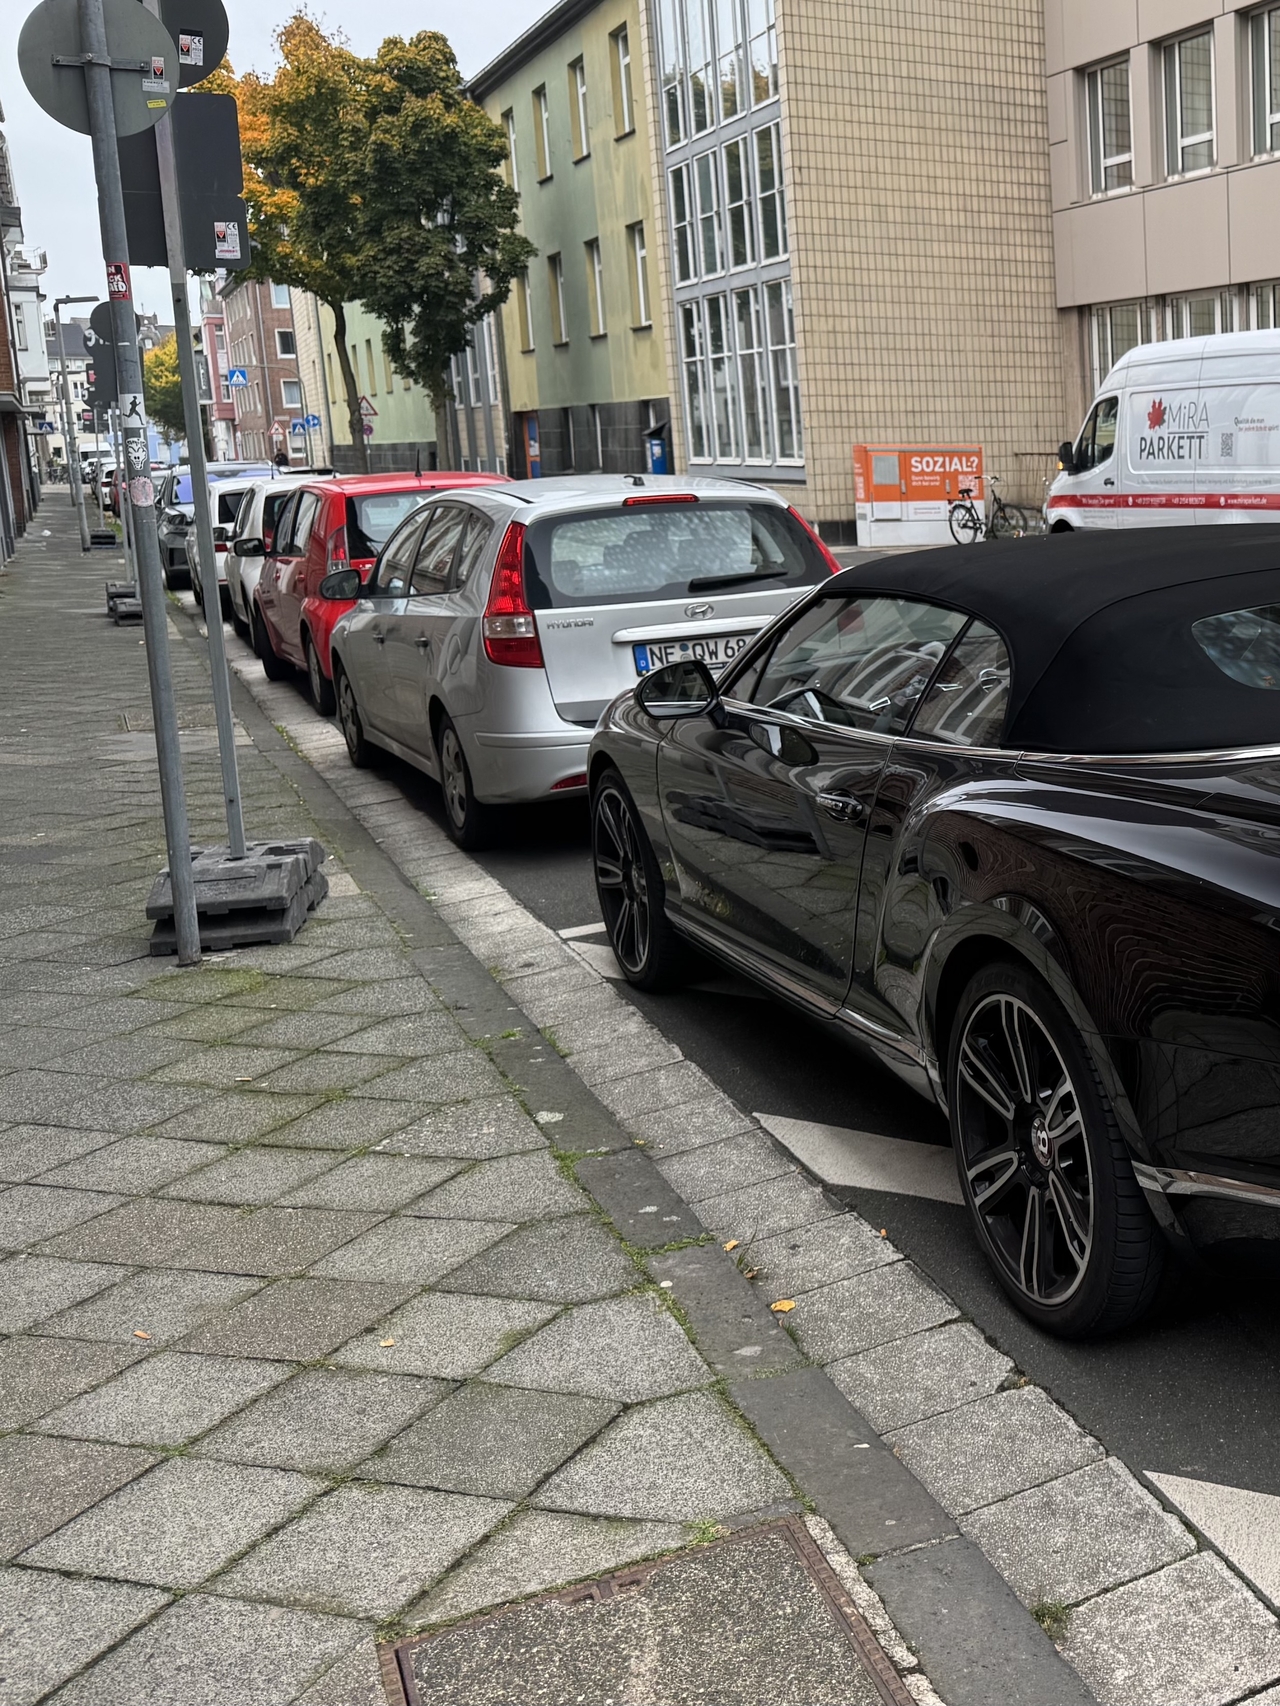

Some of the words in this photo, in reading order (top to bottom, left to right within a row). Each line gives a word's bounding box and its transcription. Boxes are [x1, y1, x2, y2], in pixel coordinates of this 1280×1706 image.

[1167, 401, 1210, 430] MiRA
[1139, 434, 1205, 460] PARKETT
[911, 456, 979, 472] SOZIAL?
[546, 617, 594, 630] HYUNDAI
[648, 644, 676, 667] NE
[692, 640, 719, 662] QW
